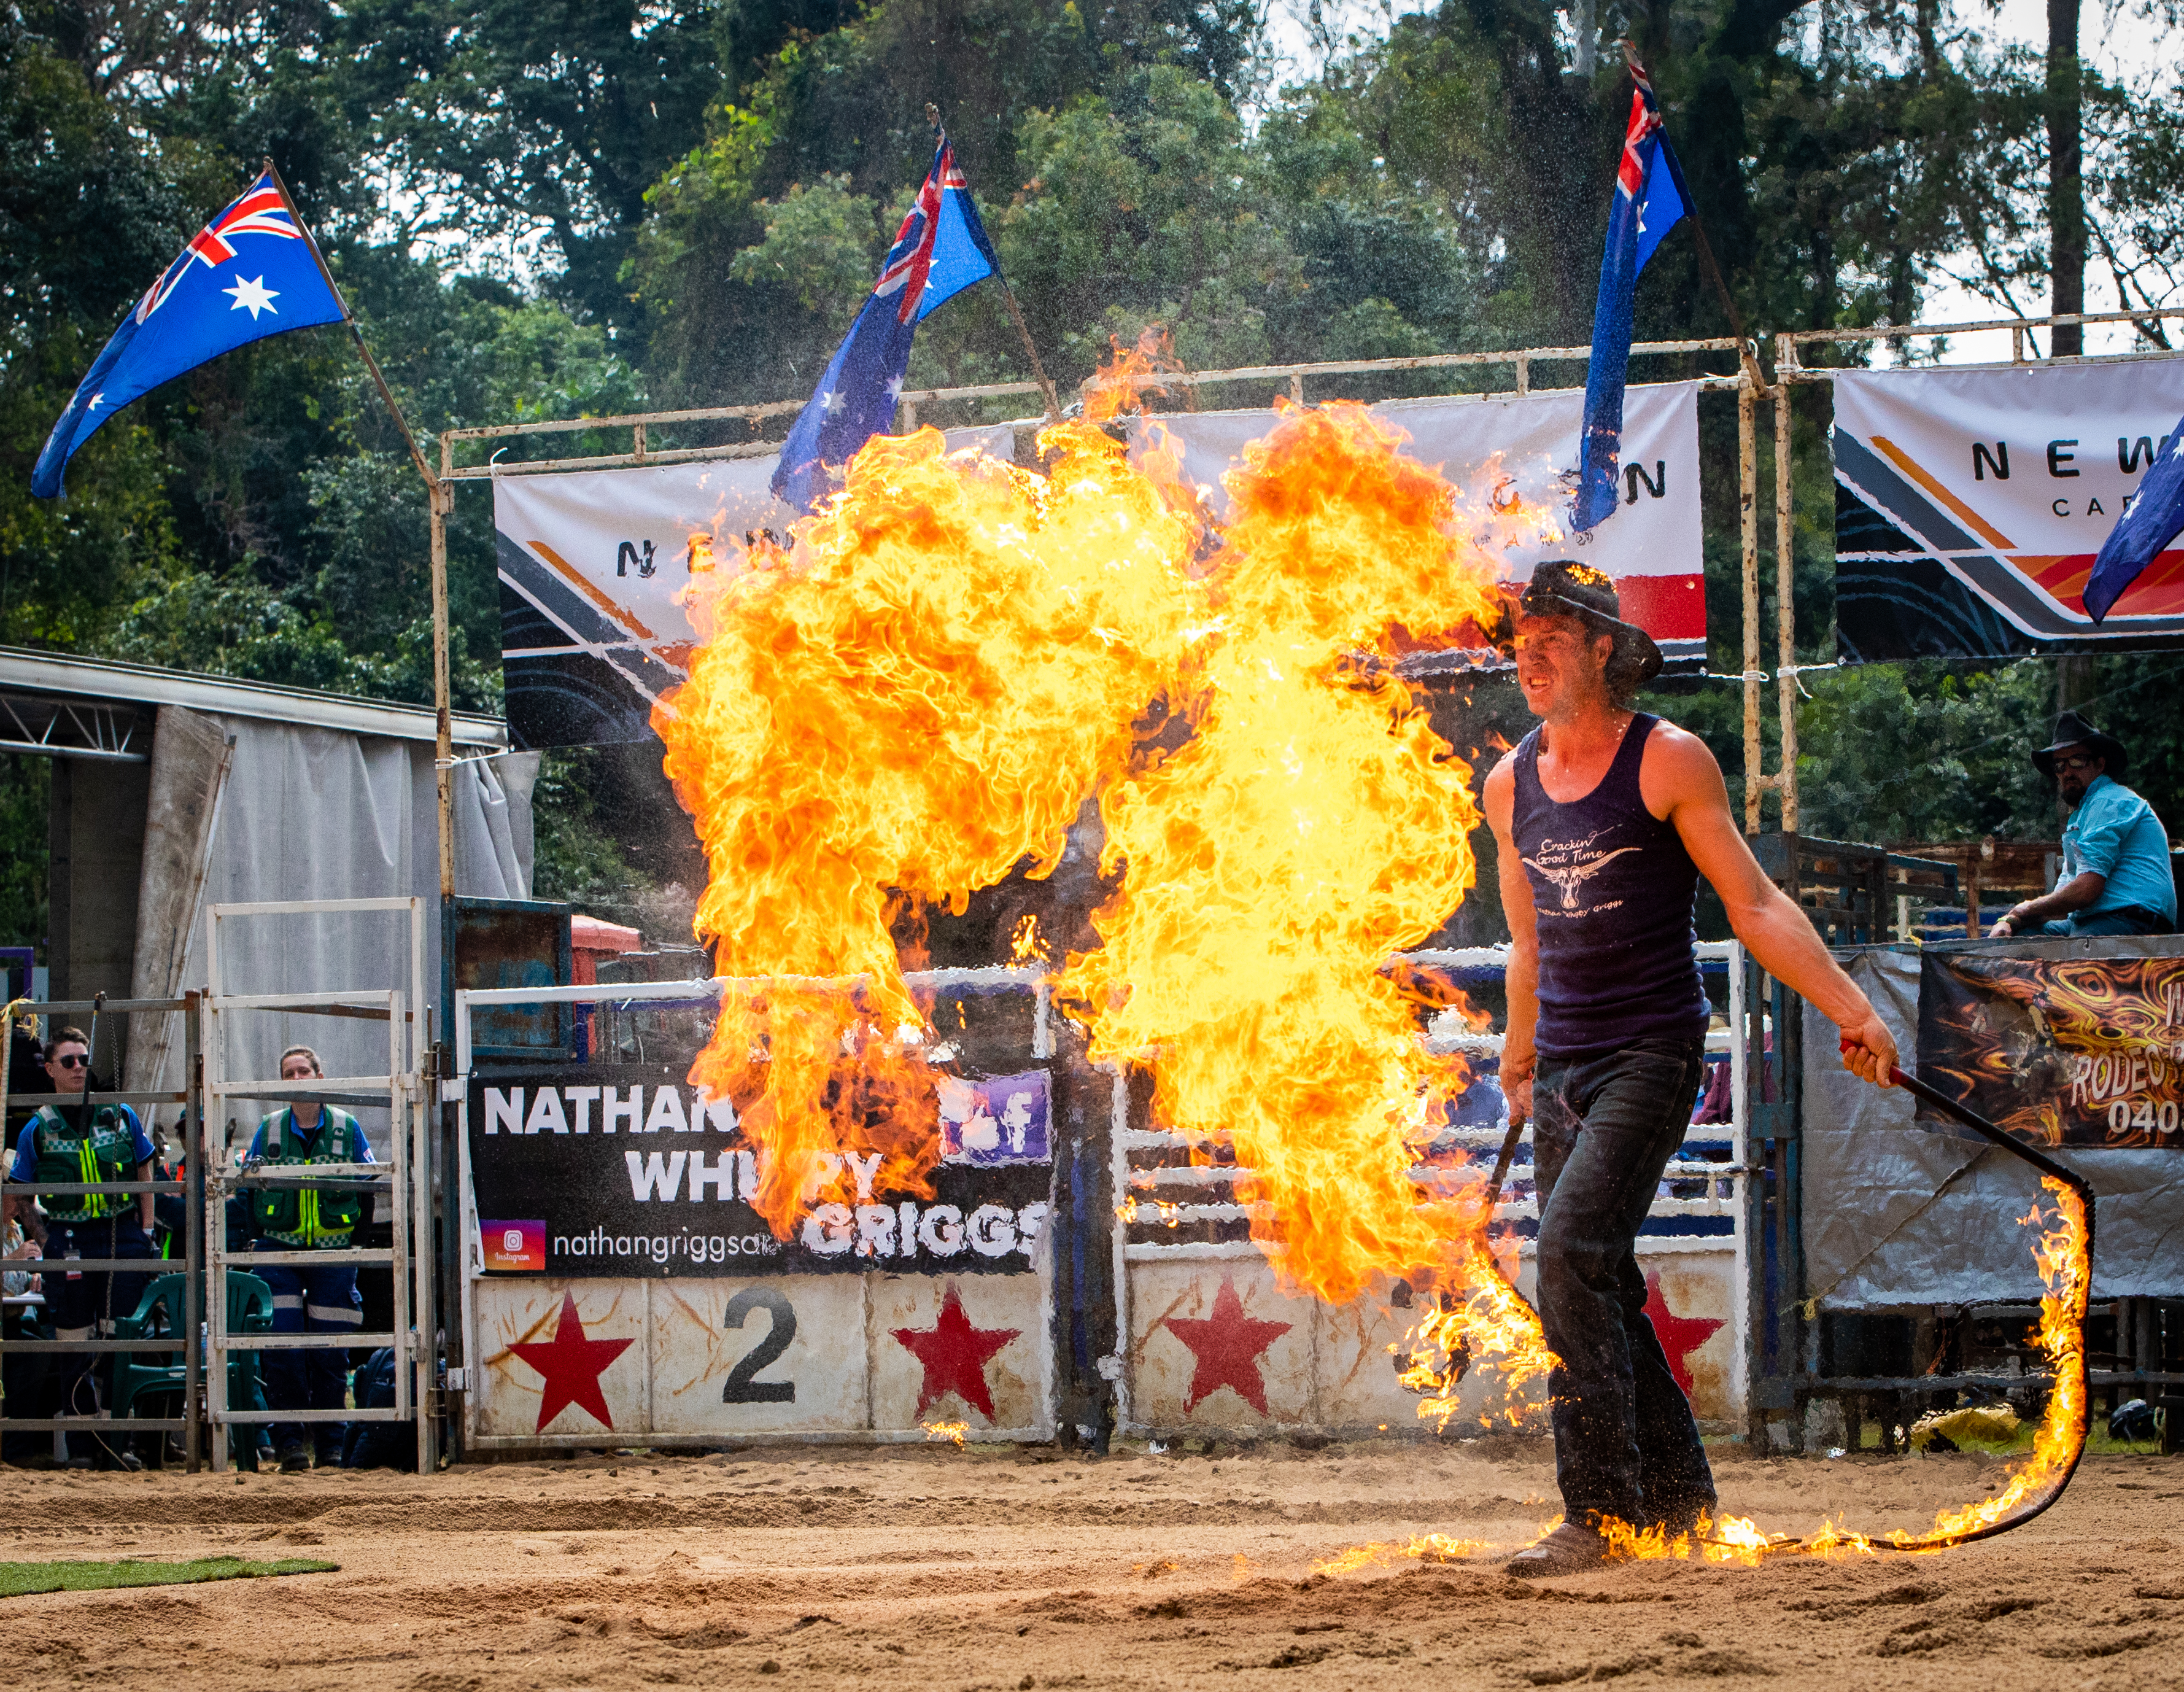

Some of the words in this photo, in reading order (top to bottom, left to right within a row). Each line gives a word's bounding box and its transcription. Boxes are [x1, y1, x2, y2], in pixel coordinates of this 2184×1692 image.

[1536, 851, 1568, 866] Good
[1572, 848, 1606, 864] Time
[1593, 899, 1624, 913] Griggs
[2071, 1044, 2165, 1107] RODEO
[484, 1084, 743, 1135] NATHAN
[2108, 1100, 2184, 1134] 040
[625, 1149, 886, 1203] WHIPY
[495, 1252, 530, 1264] Instagram
[722, 1286, 797, 1404] 2
